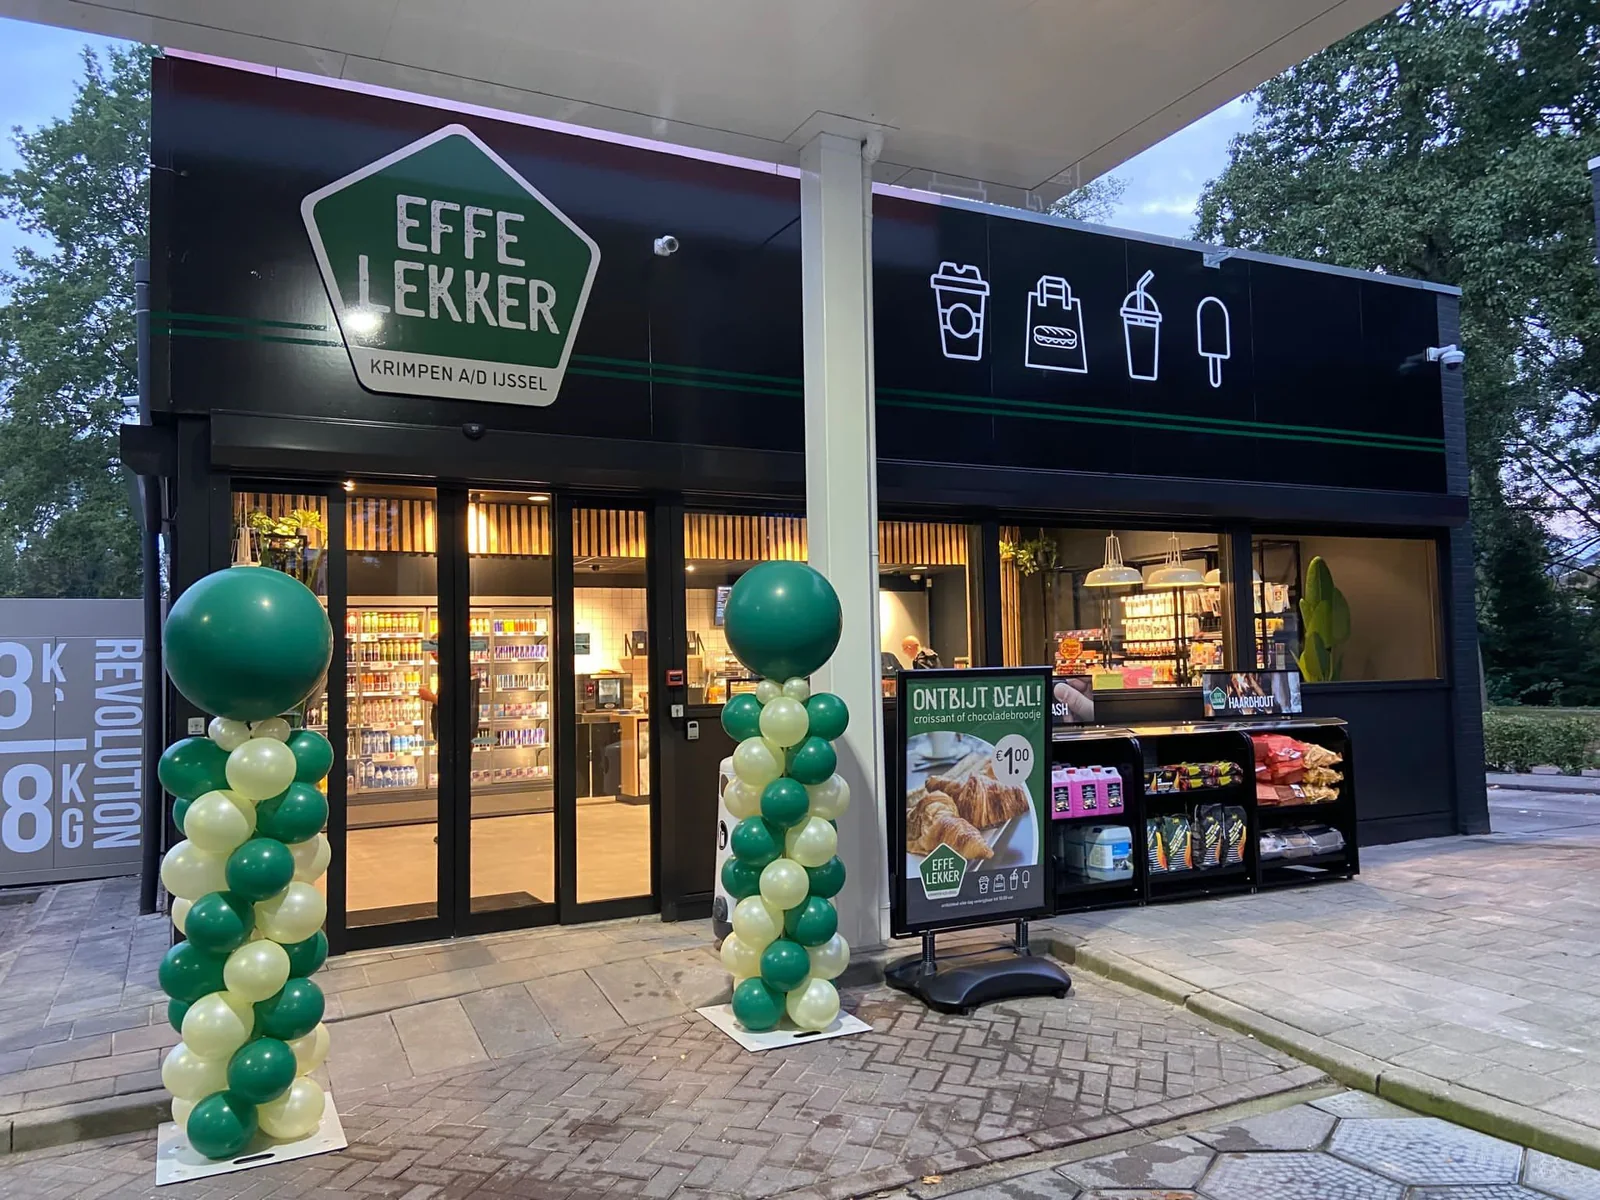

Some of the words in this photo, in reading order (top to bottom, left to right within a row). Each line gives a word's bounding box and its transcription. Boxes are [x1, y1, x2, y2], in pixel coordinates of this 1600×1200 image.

[396, 194, 525, 266] EFFE
[358, 255, 560, 334] LEKKER
[370, 359, 453, 382] KRIMPEN
[458, 369, 487, 386] A/D
[493, 371, 547, 391] IJSSEL
[913, 686, 988, 710] ONTBIJT
[993, 685, 1041, 708] DEAL!
[1228, 695, 1274, 709] HAARDHOUT
[914, 713, 955, 724] croissant
[957, 712, 966, 722] of
[967, 709, 1041, 722] chocoladebroodje
[93, 639, 144, 849] REVOLUTION
[2, 763, 53, 853] 8
[926, 869, 960, 885] LEKKER
[932, 857, 955, 871] EFFE
